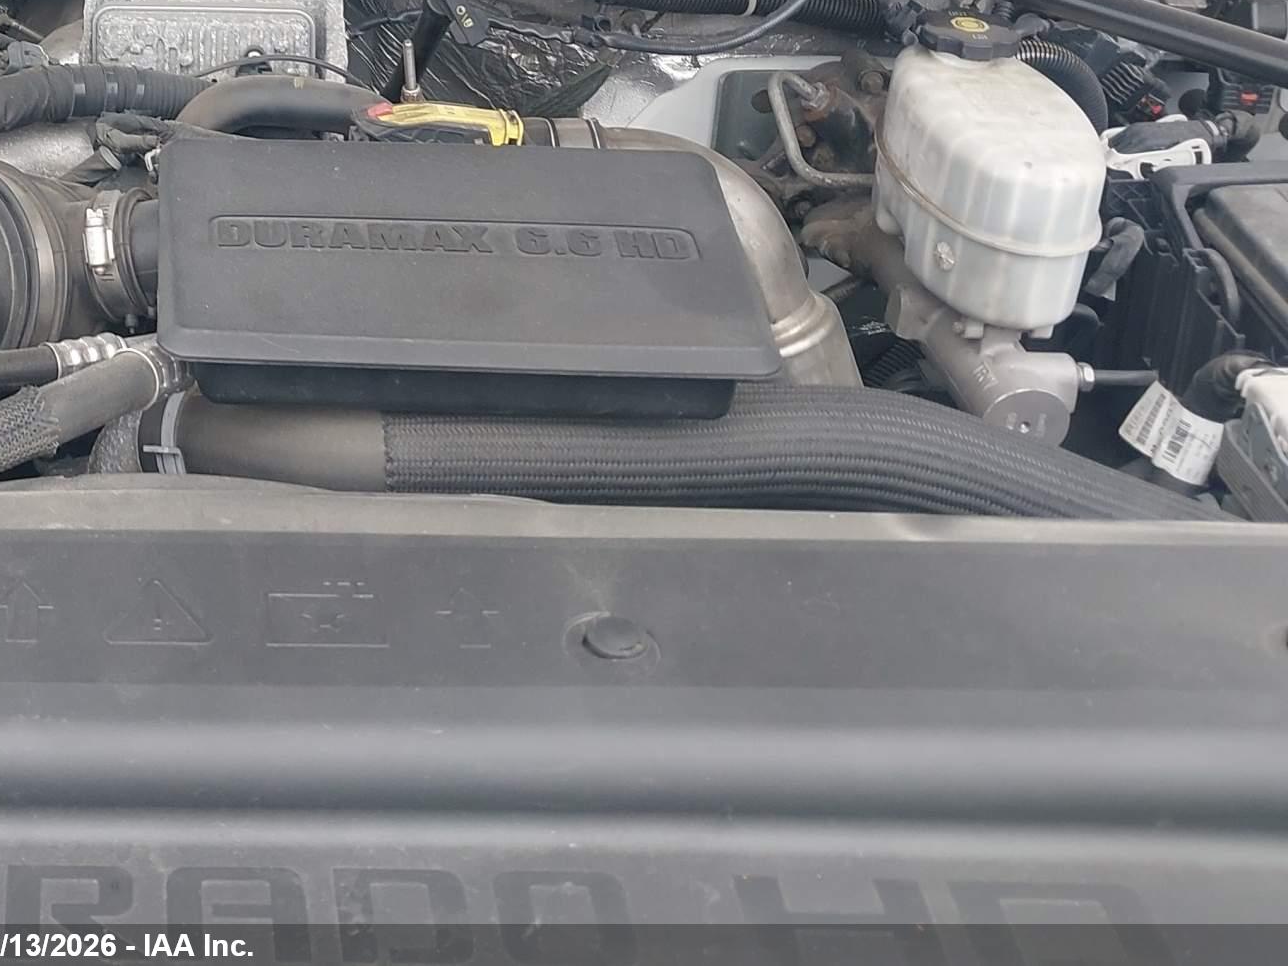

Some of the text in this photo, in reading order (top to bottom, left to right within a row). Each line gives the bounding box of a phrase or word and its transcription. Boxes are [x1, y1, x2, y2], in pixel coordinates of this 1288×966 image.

[216, 219, 691, 260] DURAMAX 6.6 HD
[732, 873, 1180, 966] HD
